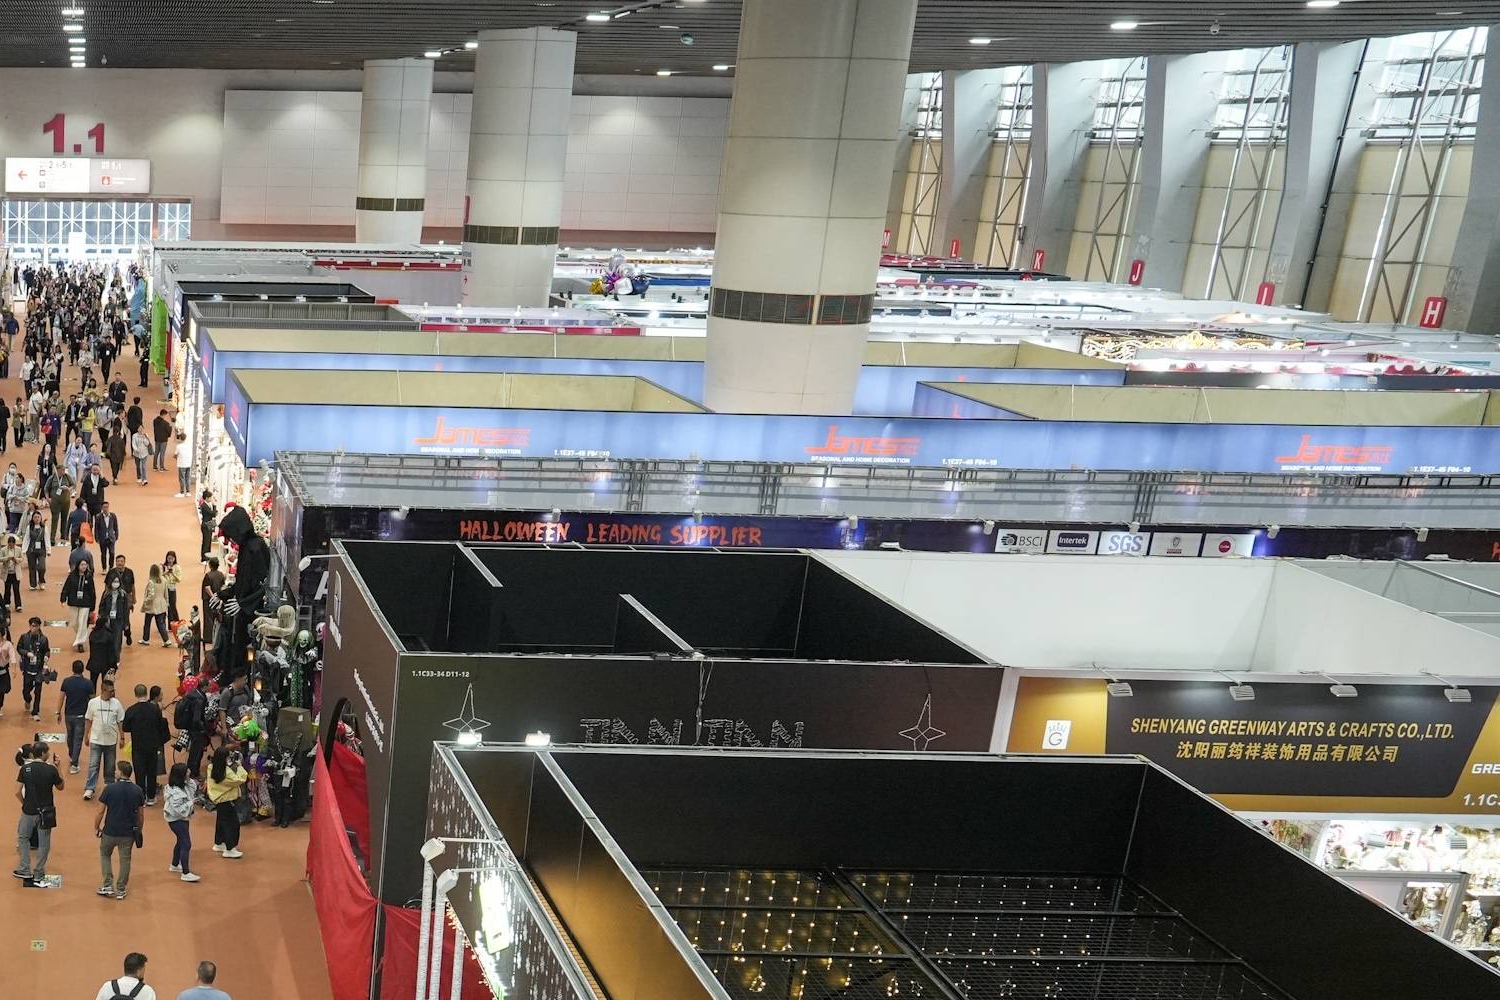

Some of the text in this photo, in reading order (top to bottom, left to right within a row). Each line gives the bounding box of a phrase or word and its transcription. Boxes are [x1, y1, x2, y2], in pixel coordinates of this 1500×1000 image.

[43, 112, 105, 153] 1.1
[1132, 263, 1142, 281] J
[1424, 301, 1442, 325] H
[459, 519, 764, 546] HALLOWEEN LEADING SUPPLIER
[1019, 536, 1043, 547] BSCI
[1058, 535, 1087, 545] Intertek
[1108, 534, 1144, 552] SGS
[1130, 718, 1455, 740] SHENYANG GREENWAY ARTS & CRAFTS CO.,LTD.
[1048, 730, 1063, 748] G
[1176, 741, 1399, 763] 沈阳丽筠祥装饰用品有限公司
[1462, 793, 1500, 807] 1.1C
